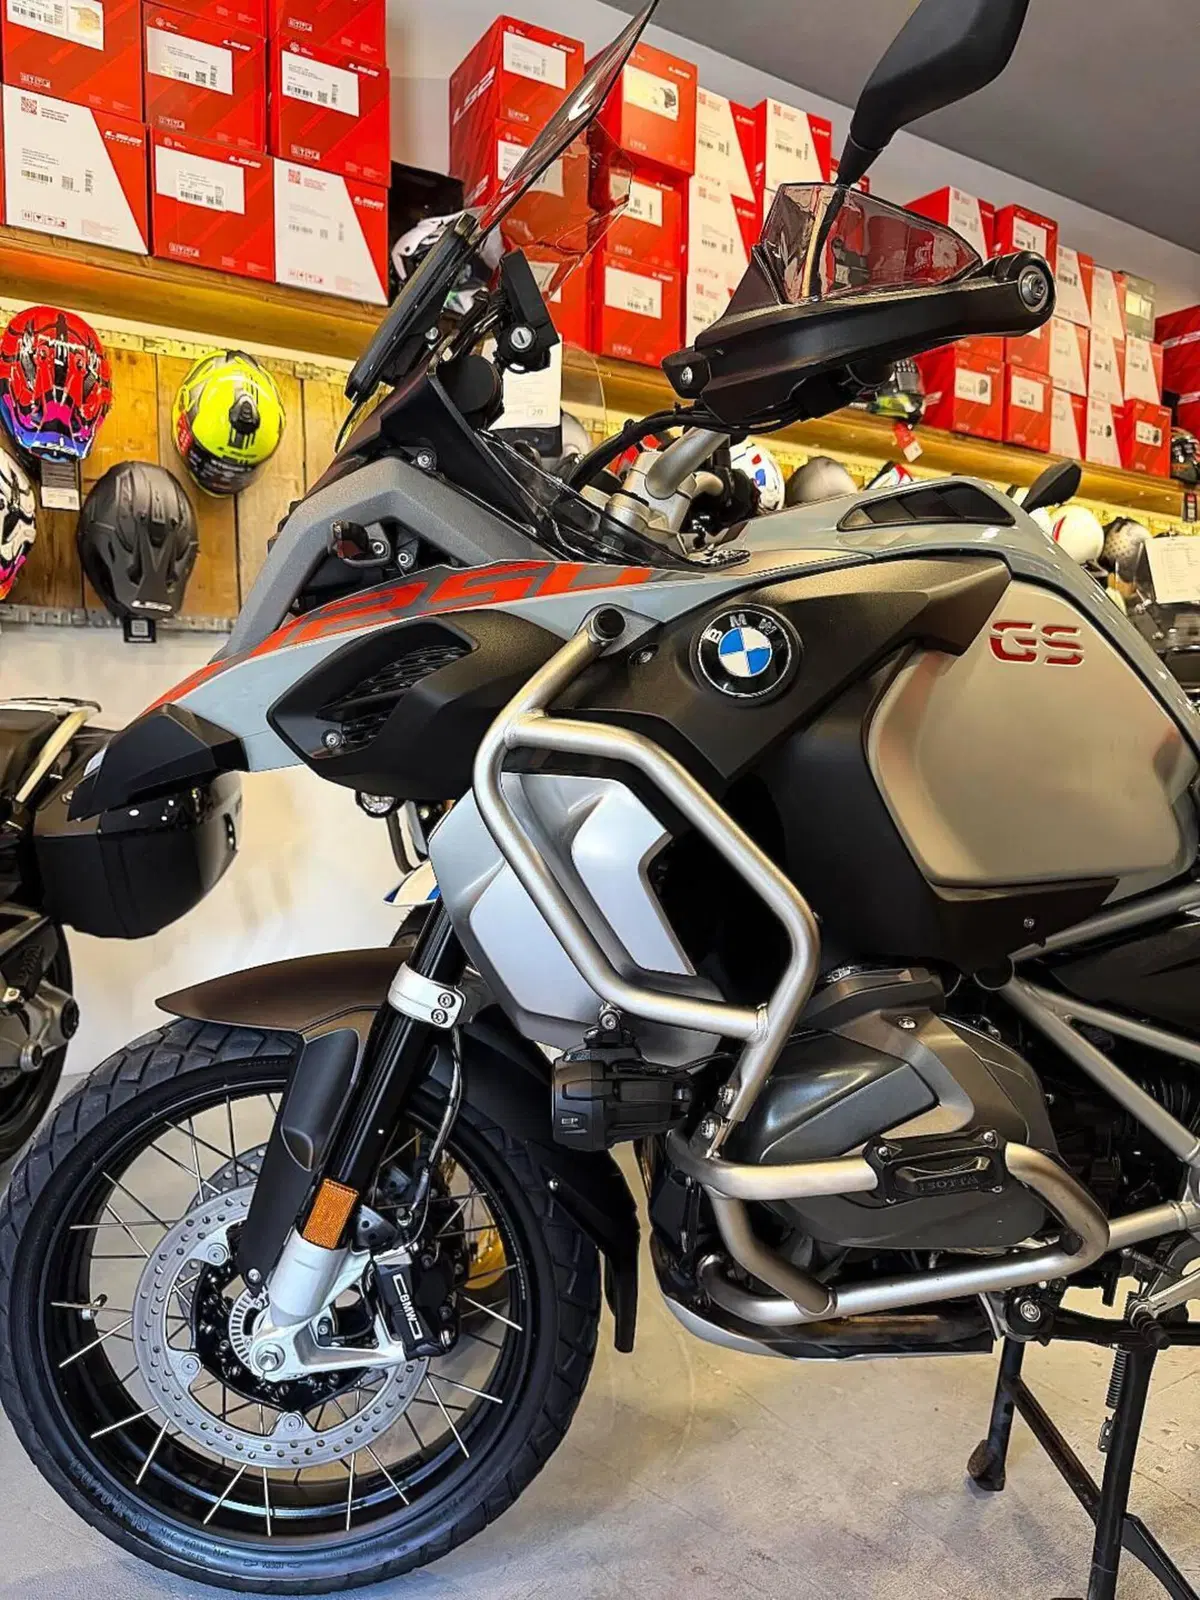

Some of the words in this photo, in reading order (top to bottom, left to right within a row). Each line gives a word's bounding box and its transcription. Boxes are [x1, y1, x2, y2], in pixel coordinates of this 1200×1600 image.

[701, 613, 778, 644] BMW
[988, 621, 1085, 667] GS
[400, 1294, 417, 1321] BMW
